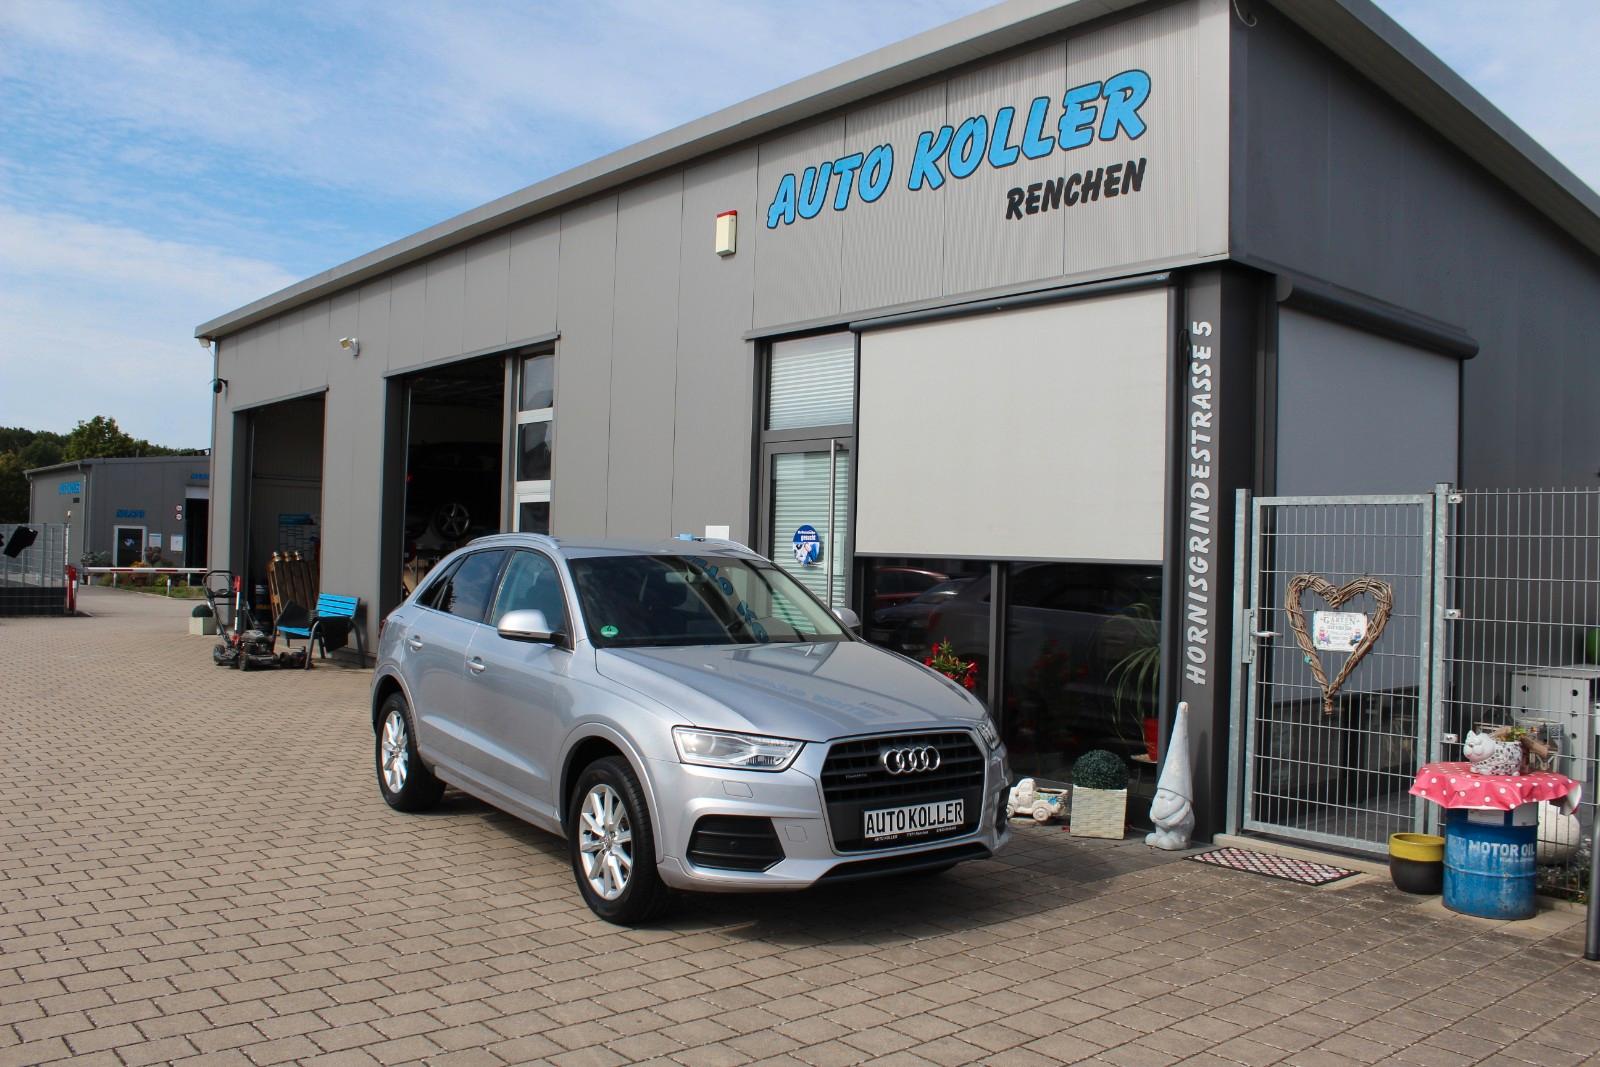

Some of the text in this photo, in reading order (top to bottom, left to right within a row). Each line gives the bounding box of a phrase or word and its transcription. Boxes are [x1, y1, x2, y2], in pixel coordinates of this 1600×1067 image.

[766, 69, 1152, 229] AUTO KOLLER
[1005, 157, 1147, 220] RENCHEN
[1185, 321, 1213, 685] HORNISGRINDESTRASSE 5
[1468, 839, 1536, 858] MOTOR OIL
